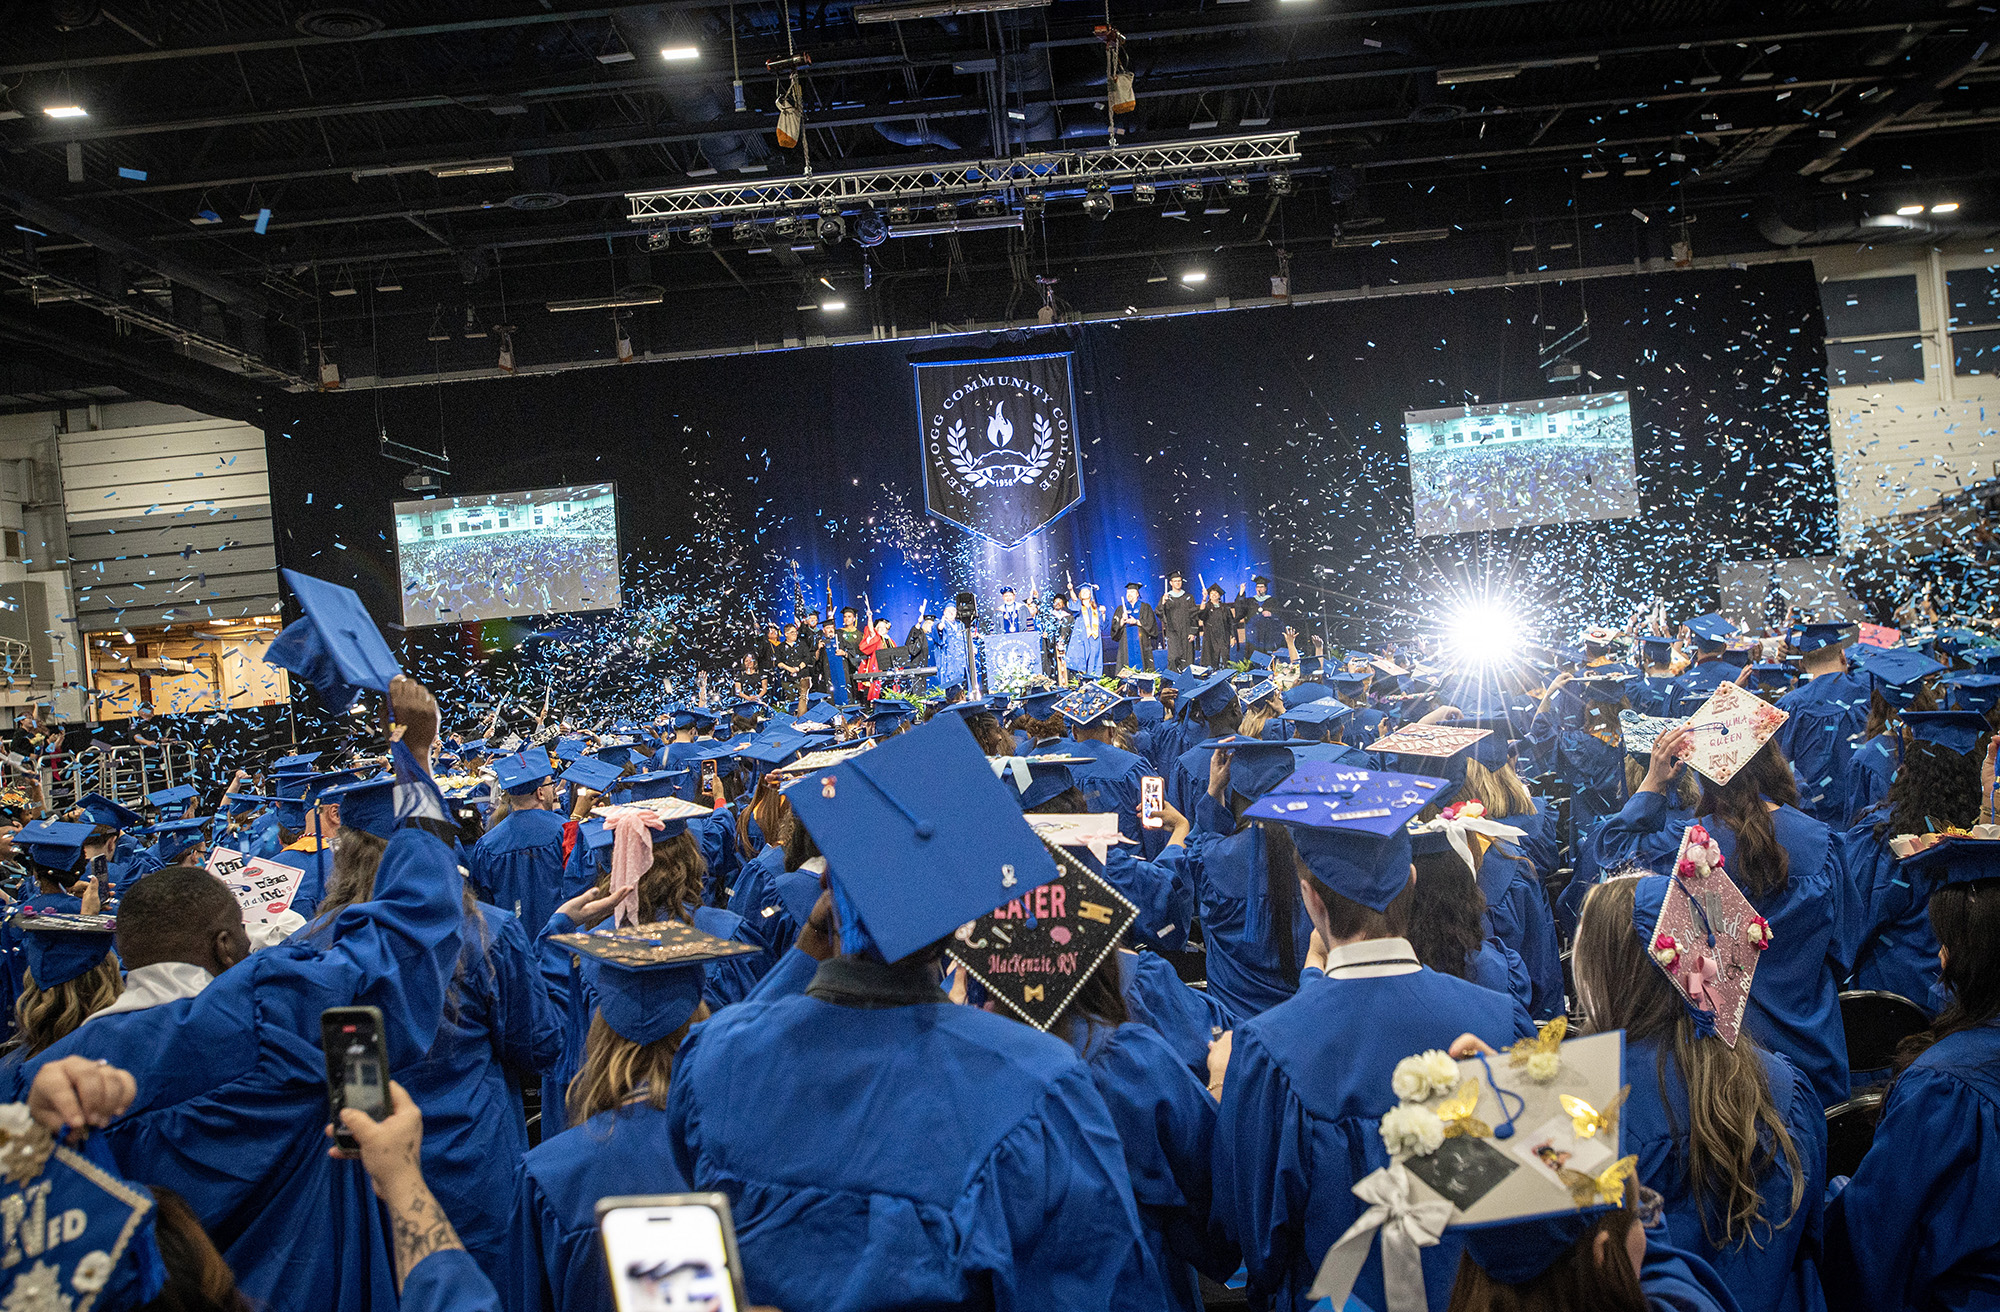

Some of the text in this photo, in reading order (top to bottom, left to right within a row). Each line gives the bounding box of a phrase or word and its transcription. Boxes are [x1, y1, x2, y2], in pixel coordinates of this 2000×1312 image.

[930, 376, 1069, 498] KELLOGG COMMUNITY COLLEGE
[1711, 695, 1740, 715] ER
[1707, 715, 1747, 733] TRUMA
[1709, 732, 1743, 747] QUEEN
[1708, 749, 1739, 770] RN
[1336, 771, 1370, 781] ME
[1057, 951, 1079, 976] RN
